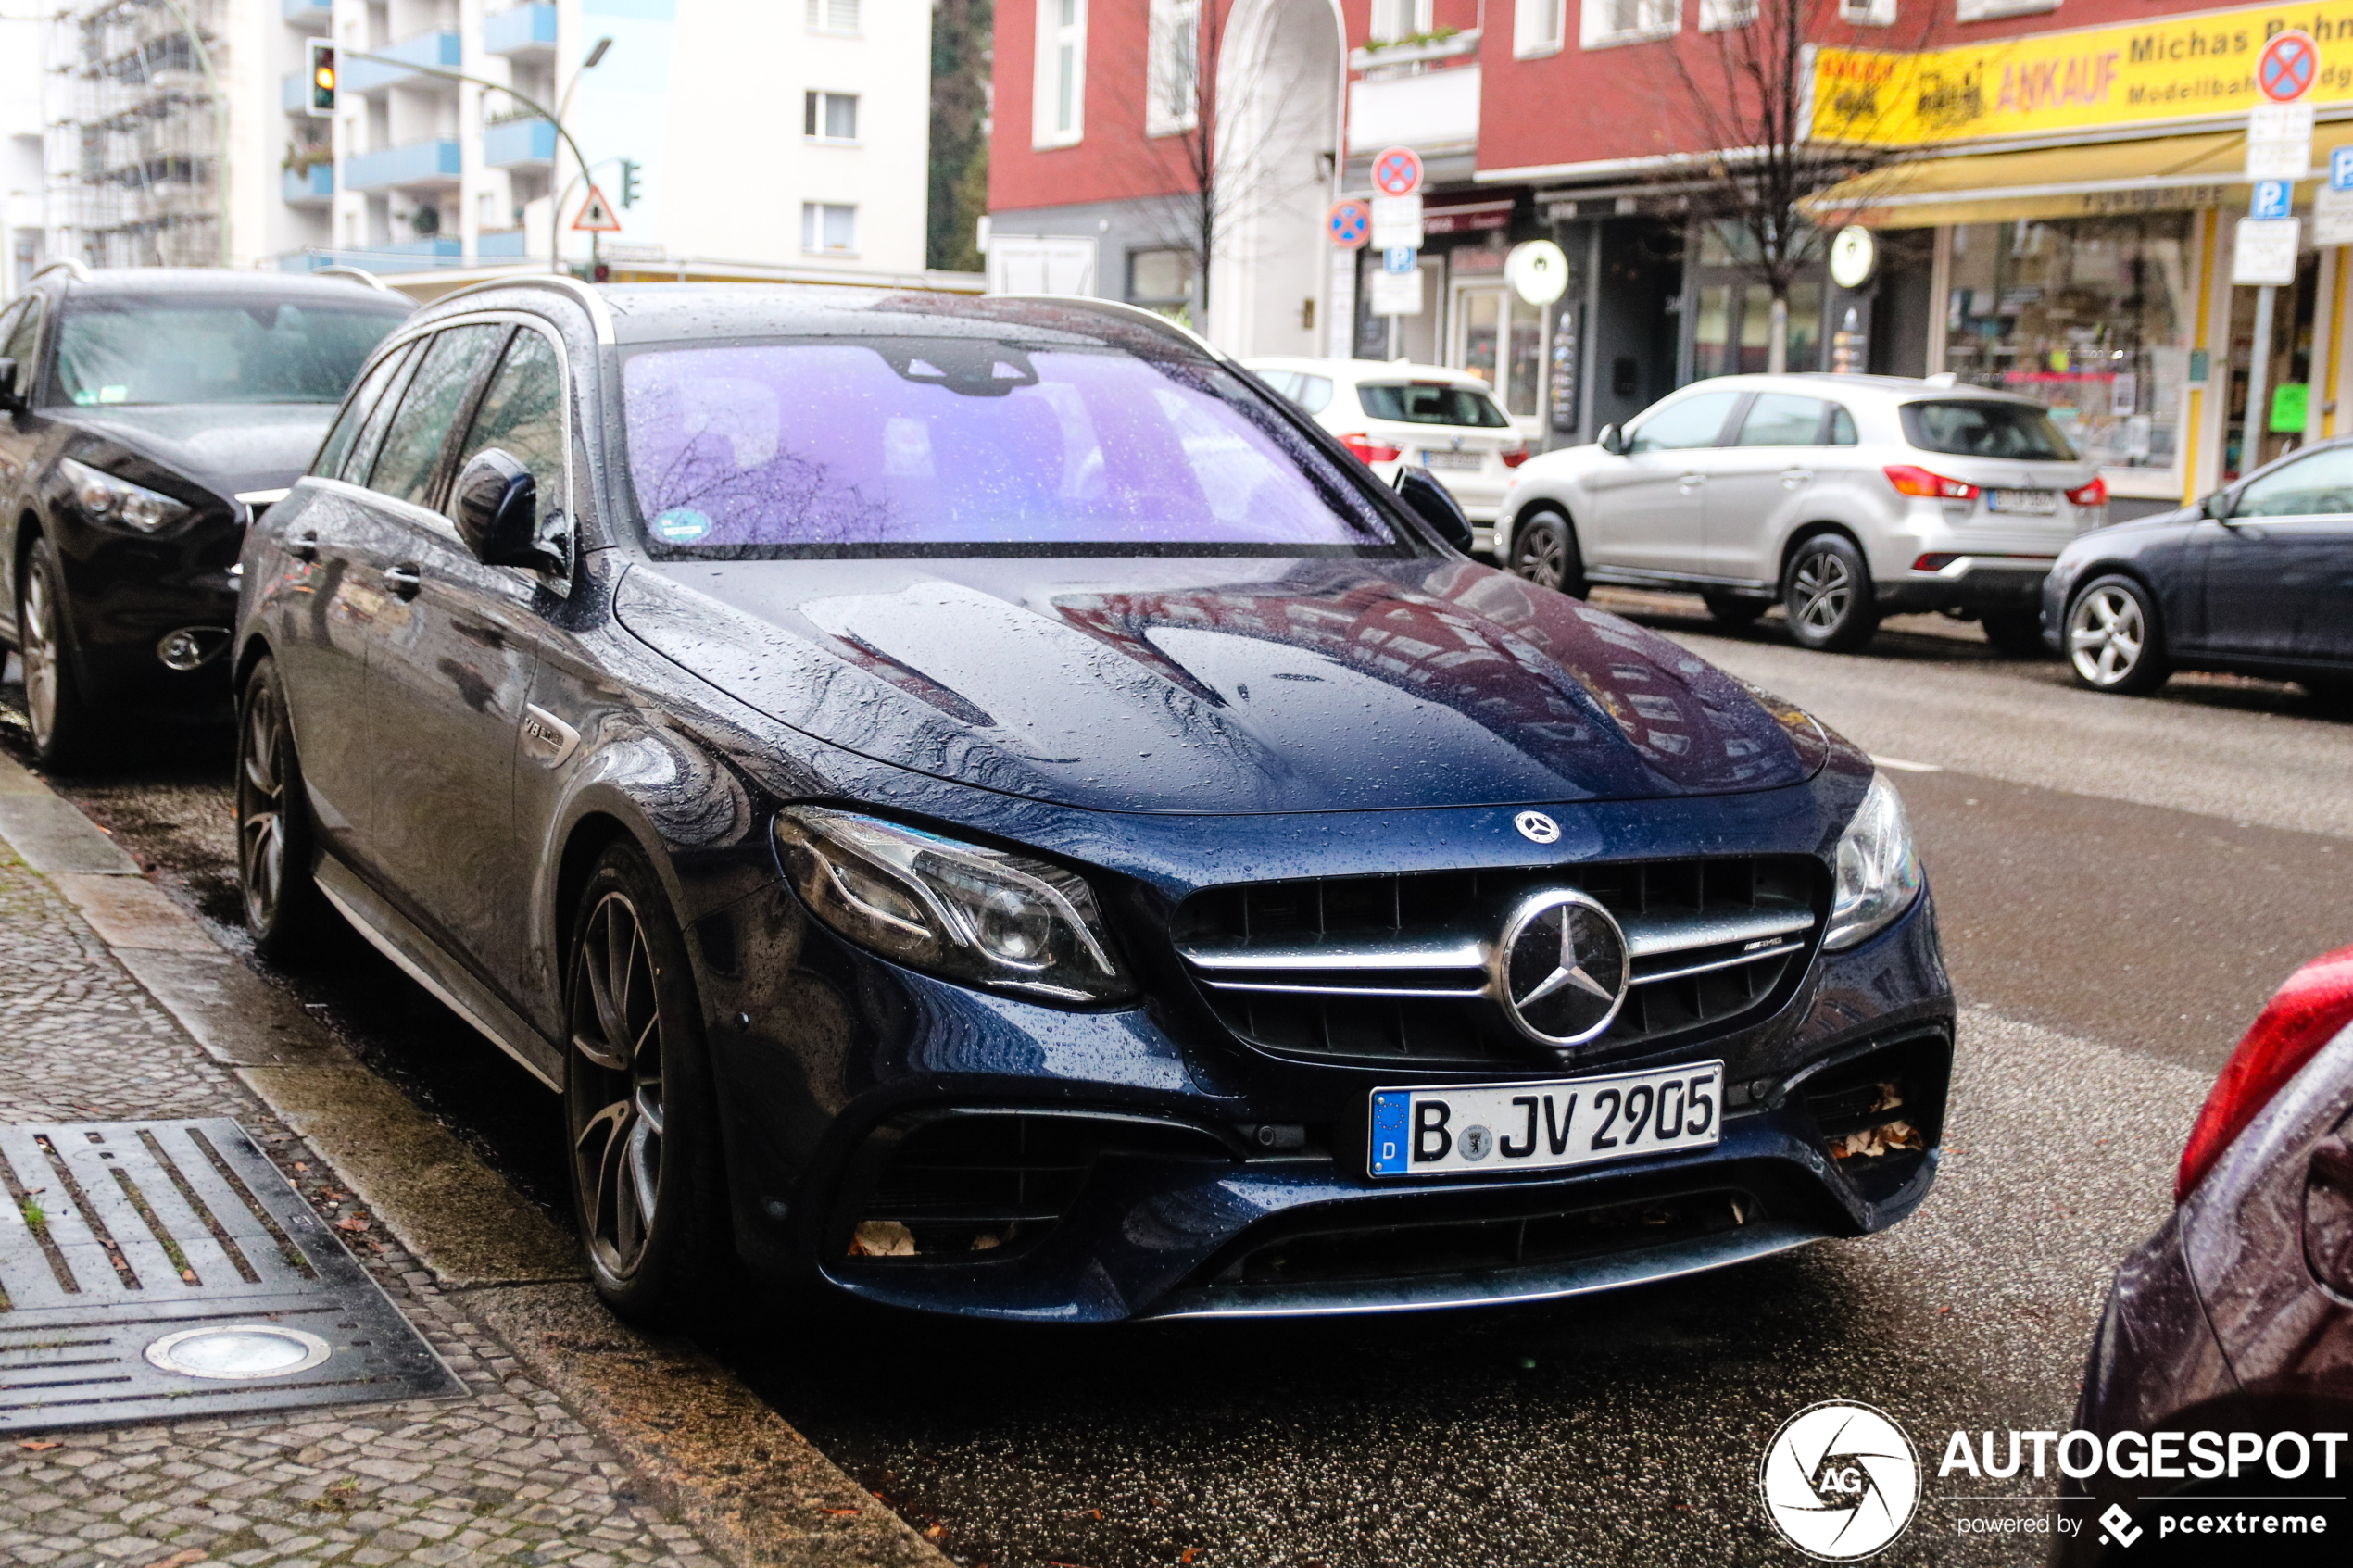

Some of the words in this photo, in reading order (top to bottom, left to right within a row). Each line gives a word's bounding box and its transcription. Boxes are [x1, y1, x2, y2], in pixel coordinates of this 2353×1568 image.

[2129, 31, 2248, 63] Michas
[1995, 50, 2120, 113] ANKAUF
[524, 718, 539, 737] V8
[1413, 1099, 1452, 1162] B
[1500, 1093, 1578, 1158] JV
[1591, 1075, 1714, 1150] 2905
[1382, 1142, 1395, 1160] D
